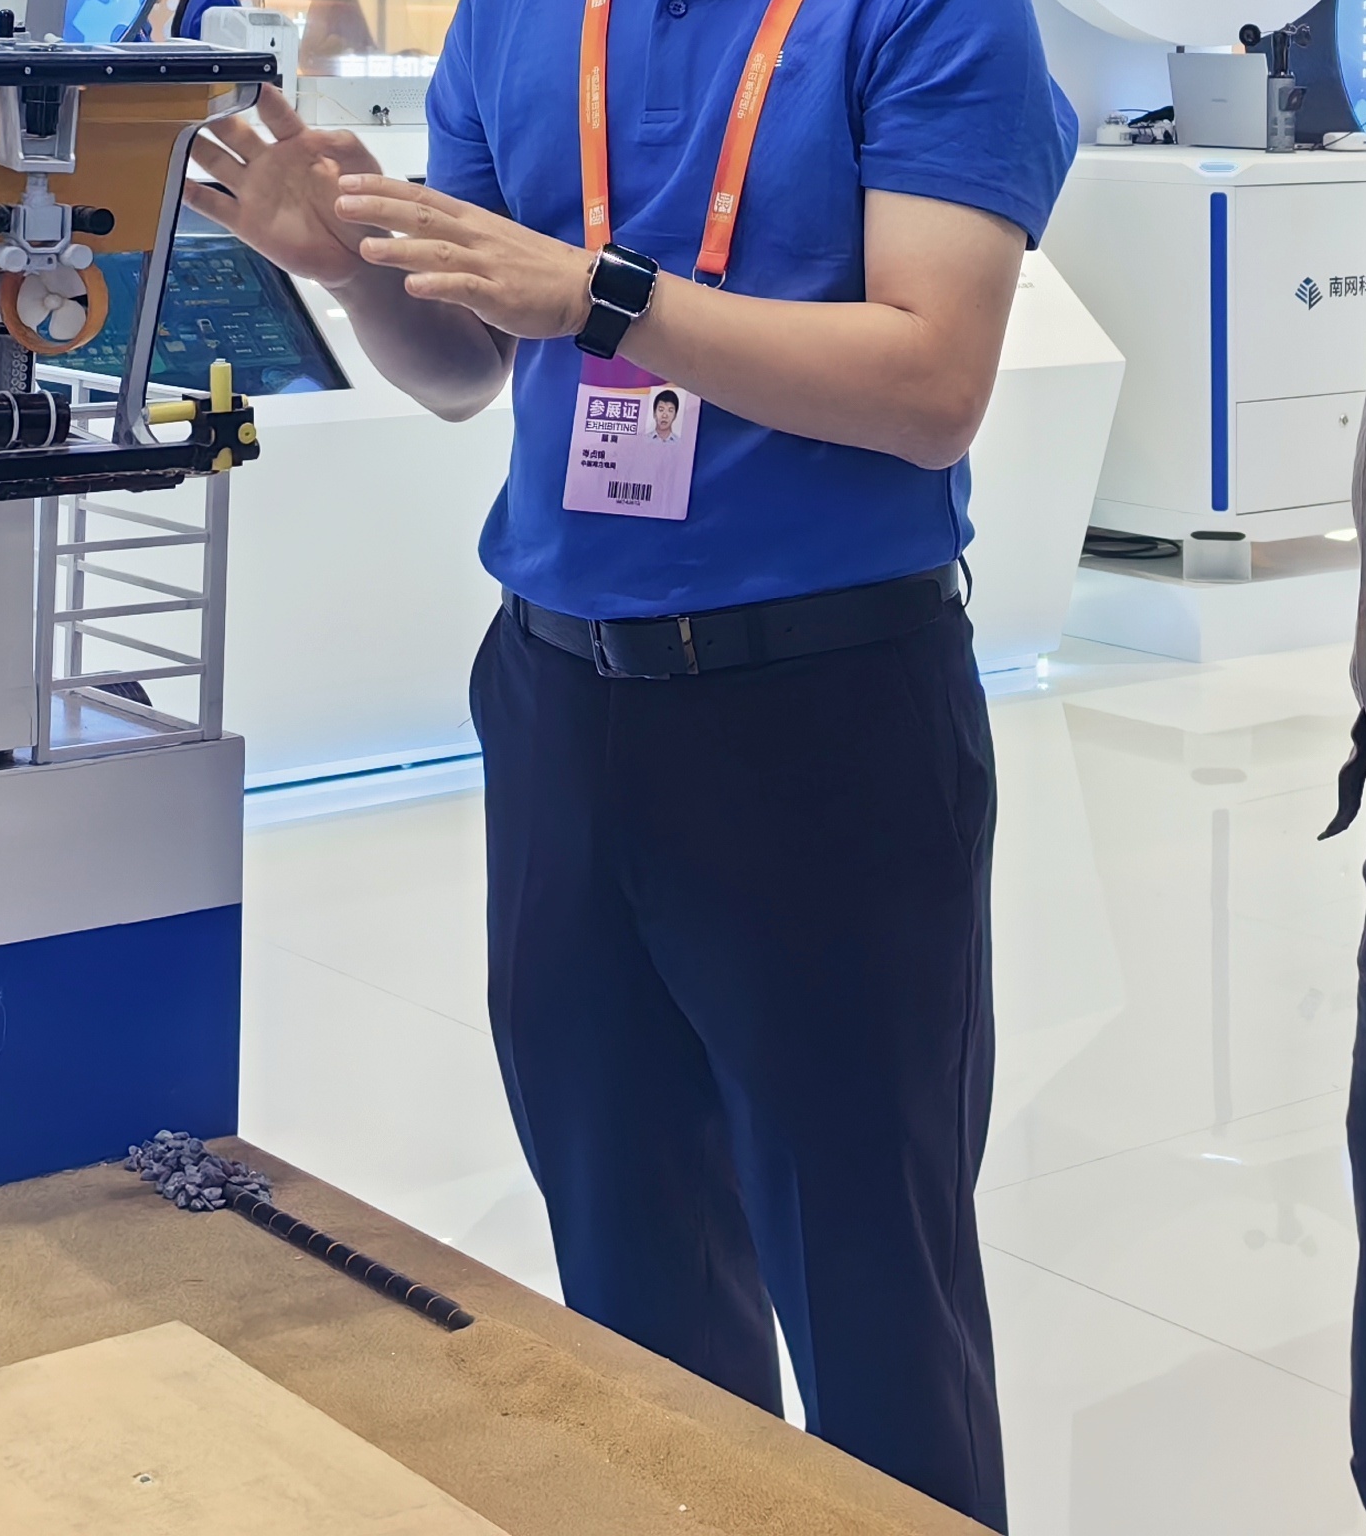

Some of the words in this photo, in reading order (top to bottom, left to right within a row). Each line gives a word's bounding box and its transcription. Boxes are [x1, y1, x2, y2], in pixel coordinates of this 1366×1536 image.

[589, 398, 640, 420] 参展证
[586, 420, 637, 433] EXHIBITING
